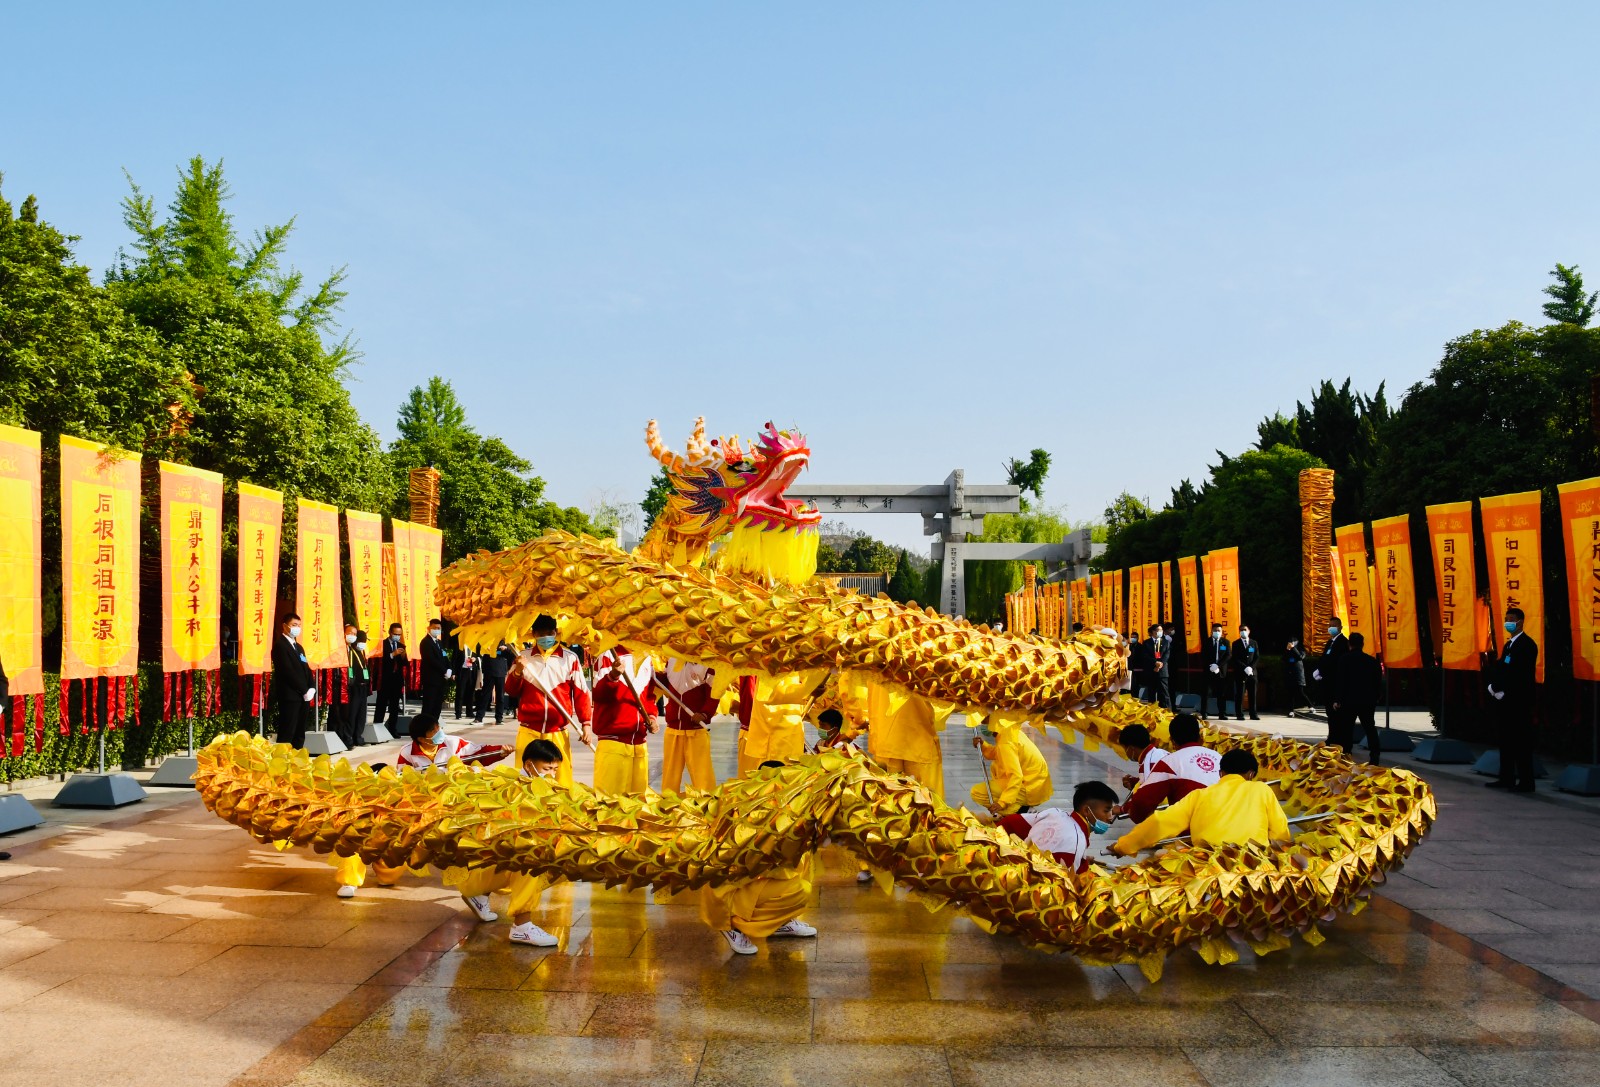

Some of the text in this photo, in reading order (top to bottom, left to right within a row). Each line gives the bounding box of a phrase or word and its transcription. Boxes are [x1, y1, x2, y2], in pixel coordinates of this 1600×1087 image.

[92, 493, 116, 641] 同根同祖同源
